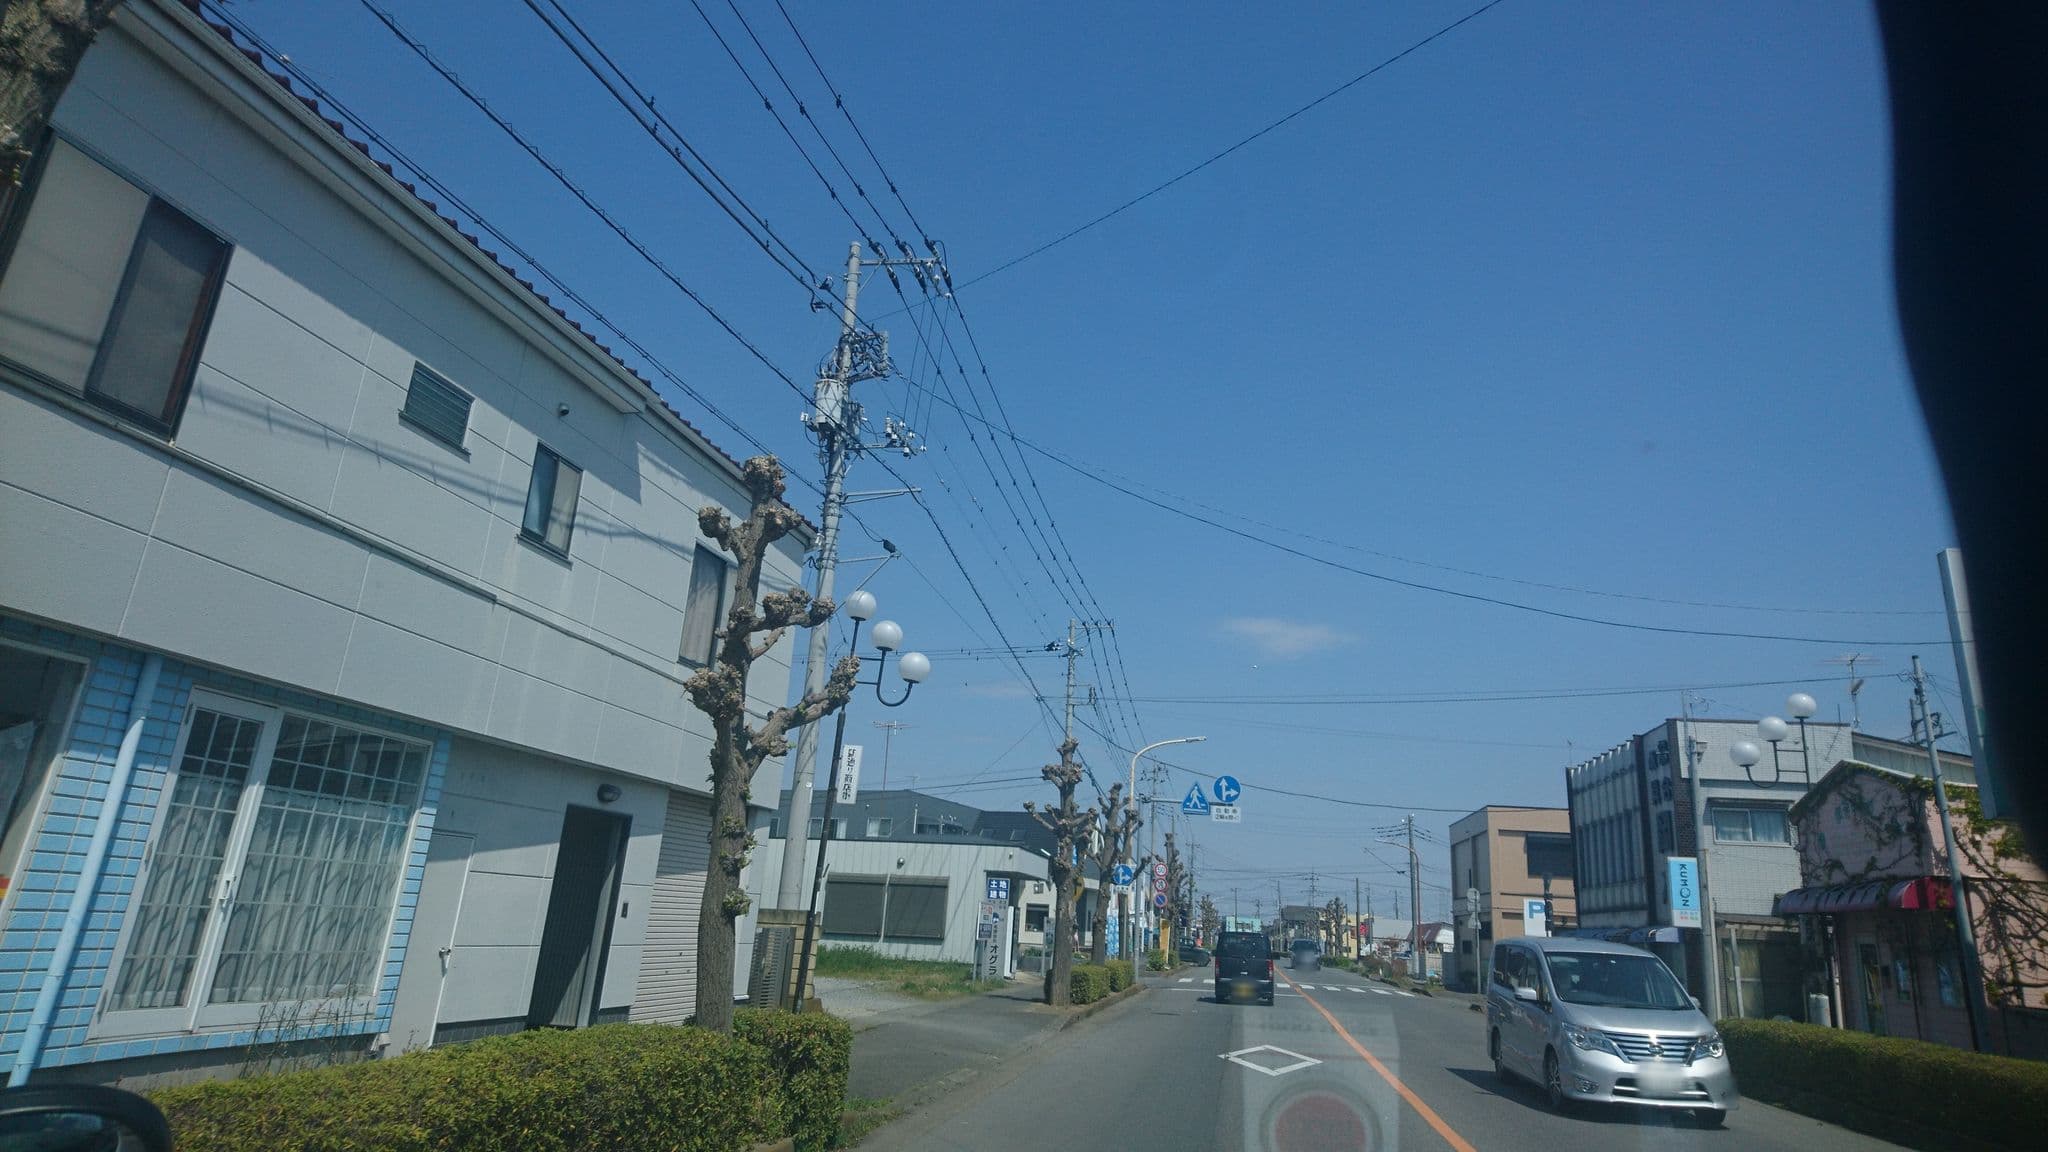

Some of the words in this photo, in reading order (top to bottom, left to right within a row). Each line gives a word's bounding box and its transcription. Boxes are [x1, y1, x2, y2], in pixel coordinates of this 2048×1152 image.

[990, 880, 1007, 888] 土地
[1679, 863, 1691, 907] KUMON
[1529, 902, 1545, 919] P
[988, 944, 999, 976] オグラ
